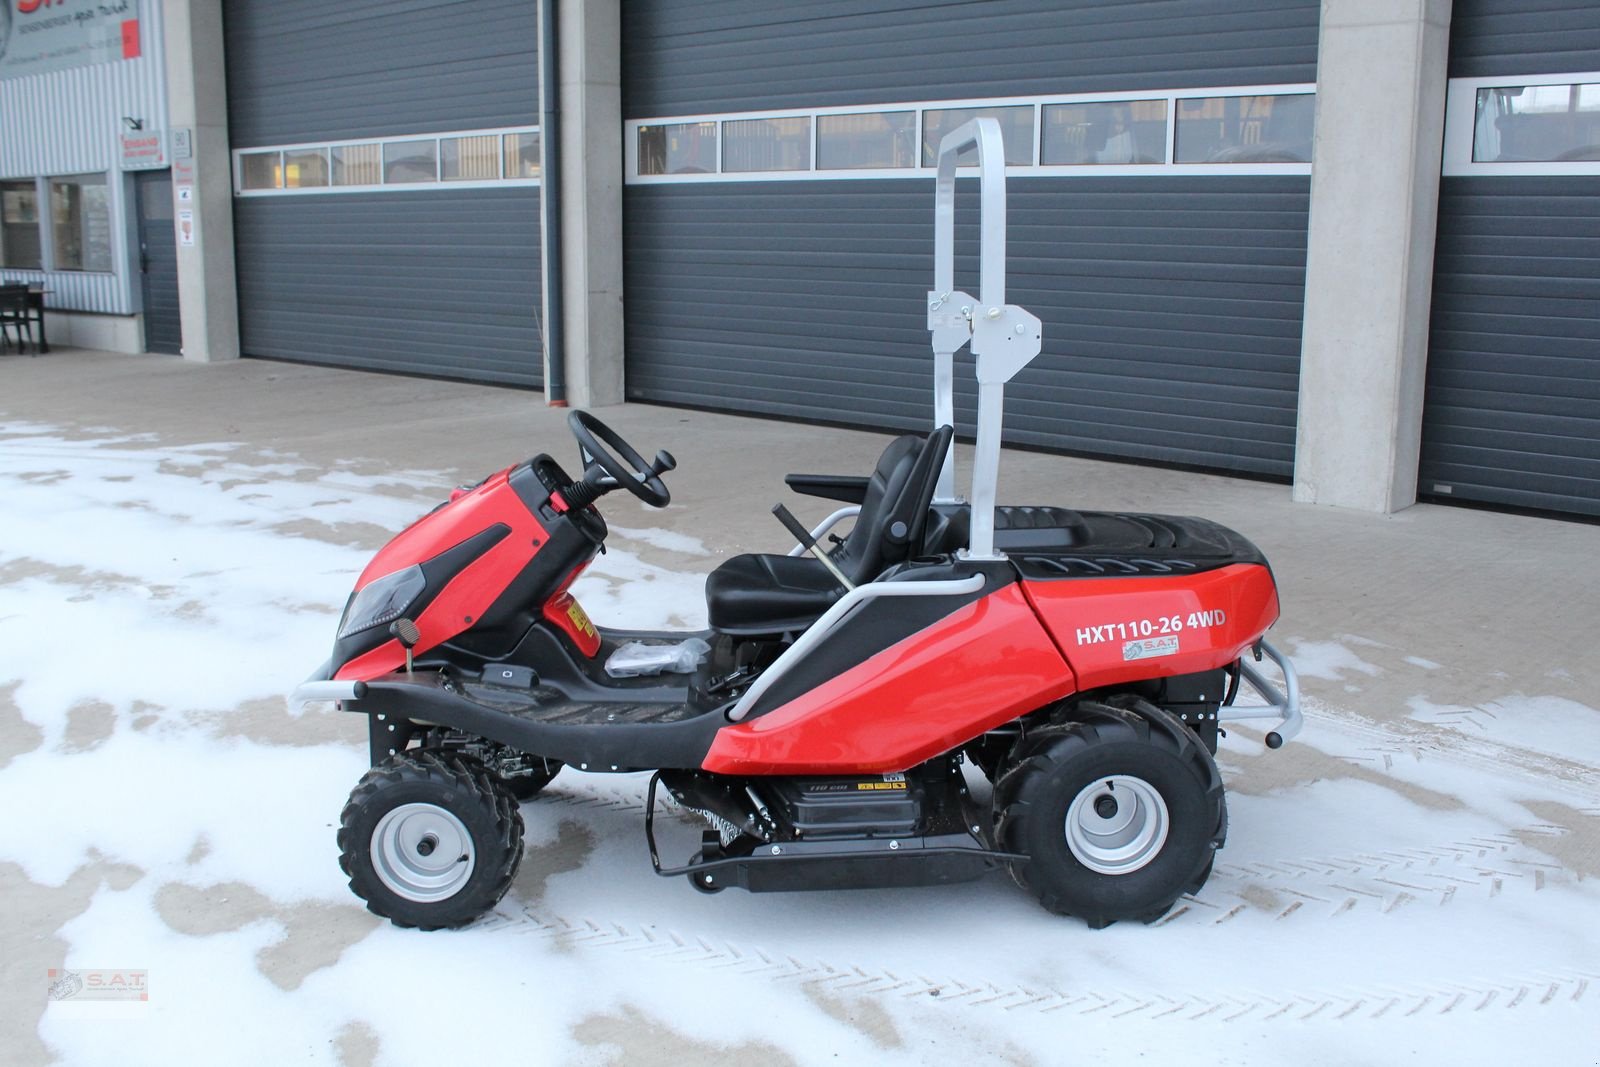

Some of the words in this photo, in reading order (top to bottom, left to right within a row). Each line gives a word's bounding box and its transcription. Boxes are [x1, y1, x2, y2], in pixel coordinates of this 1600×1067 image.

[1076, 615, 1183, 646] HXT110-26
[1186, 609, 1227, 630] 4WD
[1143, 637, 1178, 651] S.A.T.
